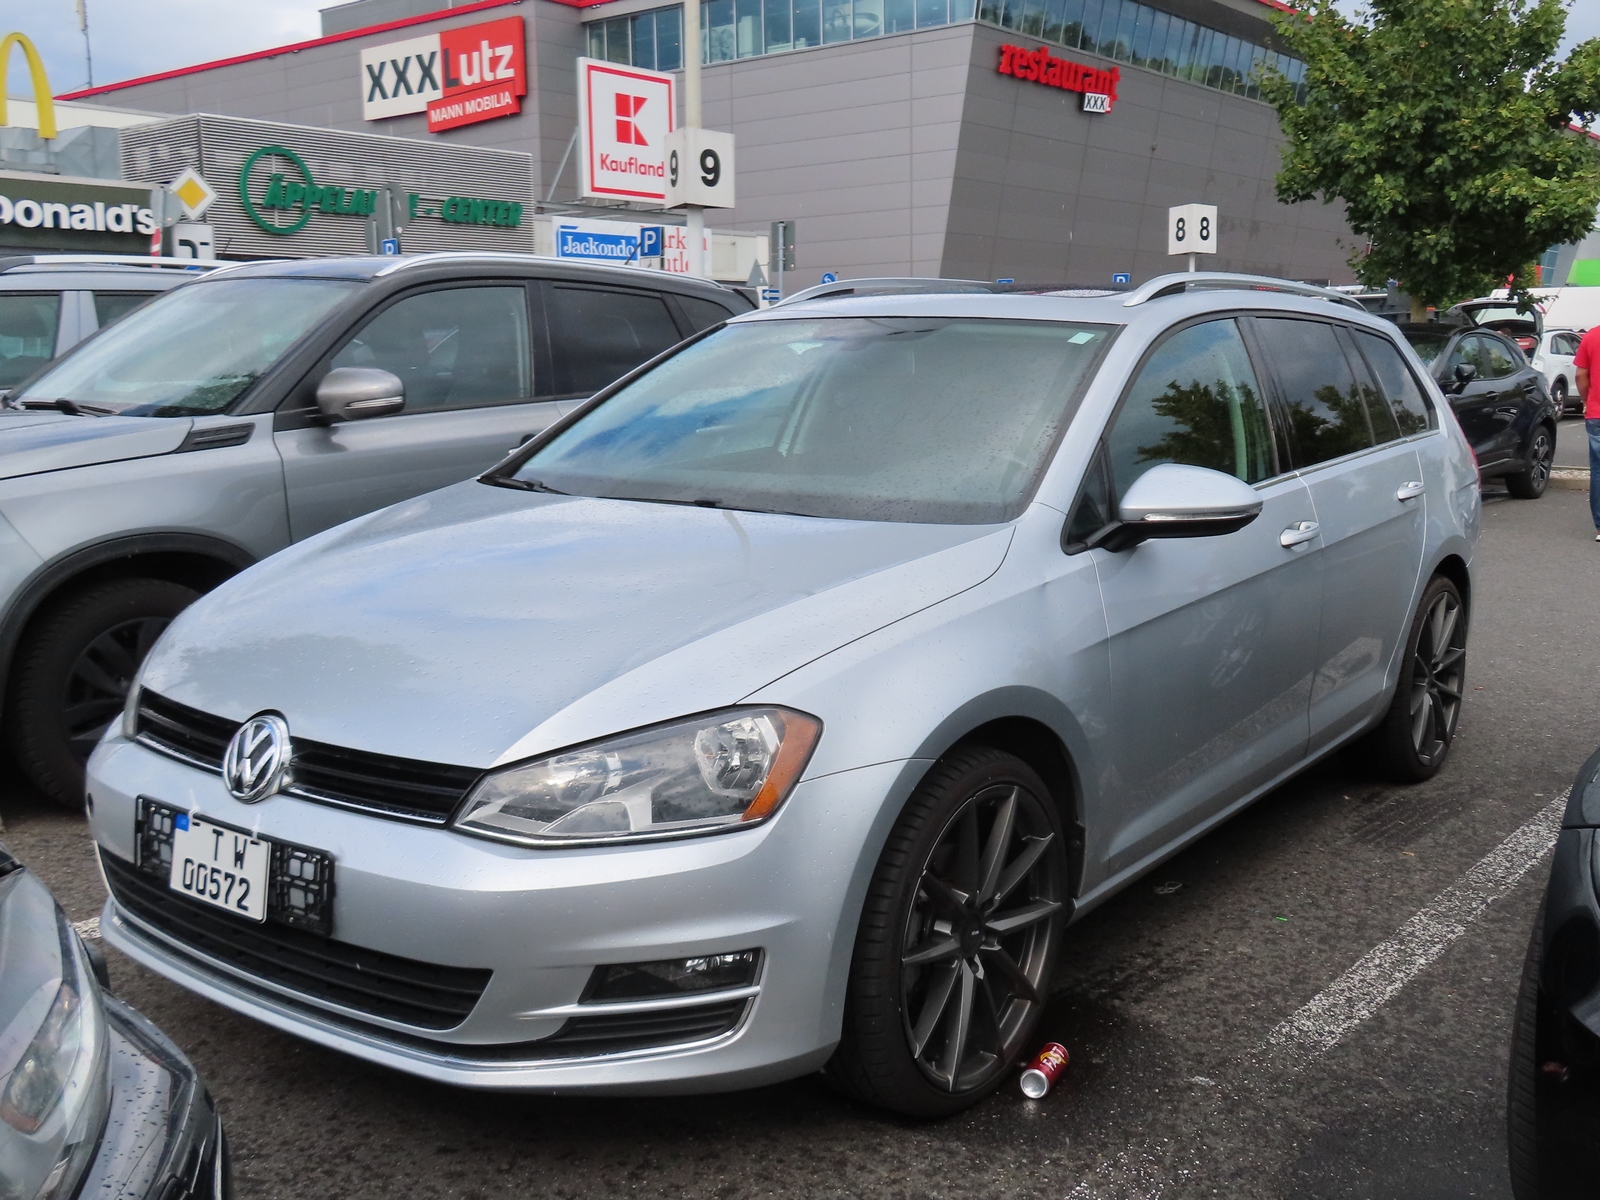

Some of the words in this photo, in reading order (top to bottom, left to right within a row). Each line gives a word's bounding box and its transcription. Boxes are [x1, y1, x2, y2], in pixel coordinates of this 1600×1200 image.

[998, 43, 1121, 102] restaurant
[431, 104, 463, 123] MANN
[465, 91, 512, 116] MOBILIA
[600, 153, 665, 177] Kaufland
[670, 150, 679, 187] 9
[700, 149, 720, 187] 9
[442, 196, 523, 227] CENTER
[644, 231, 656, 253] P
[1176, 217, 1185, 242] 8
[1200, 216, 1210, 241] 8
[564, 234, 635, 258] Jackondo
[183, 857, 250, 912] 00572
